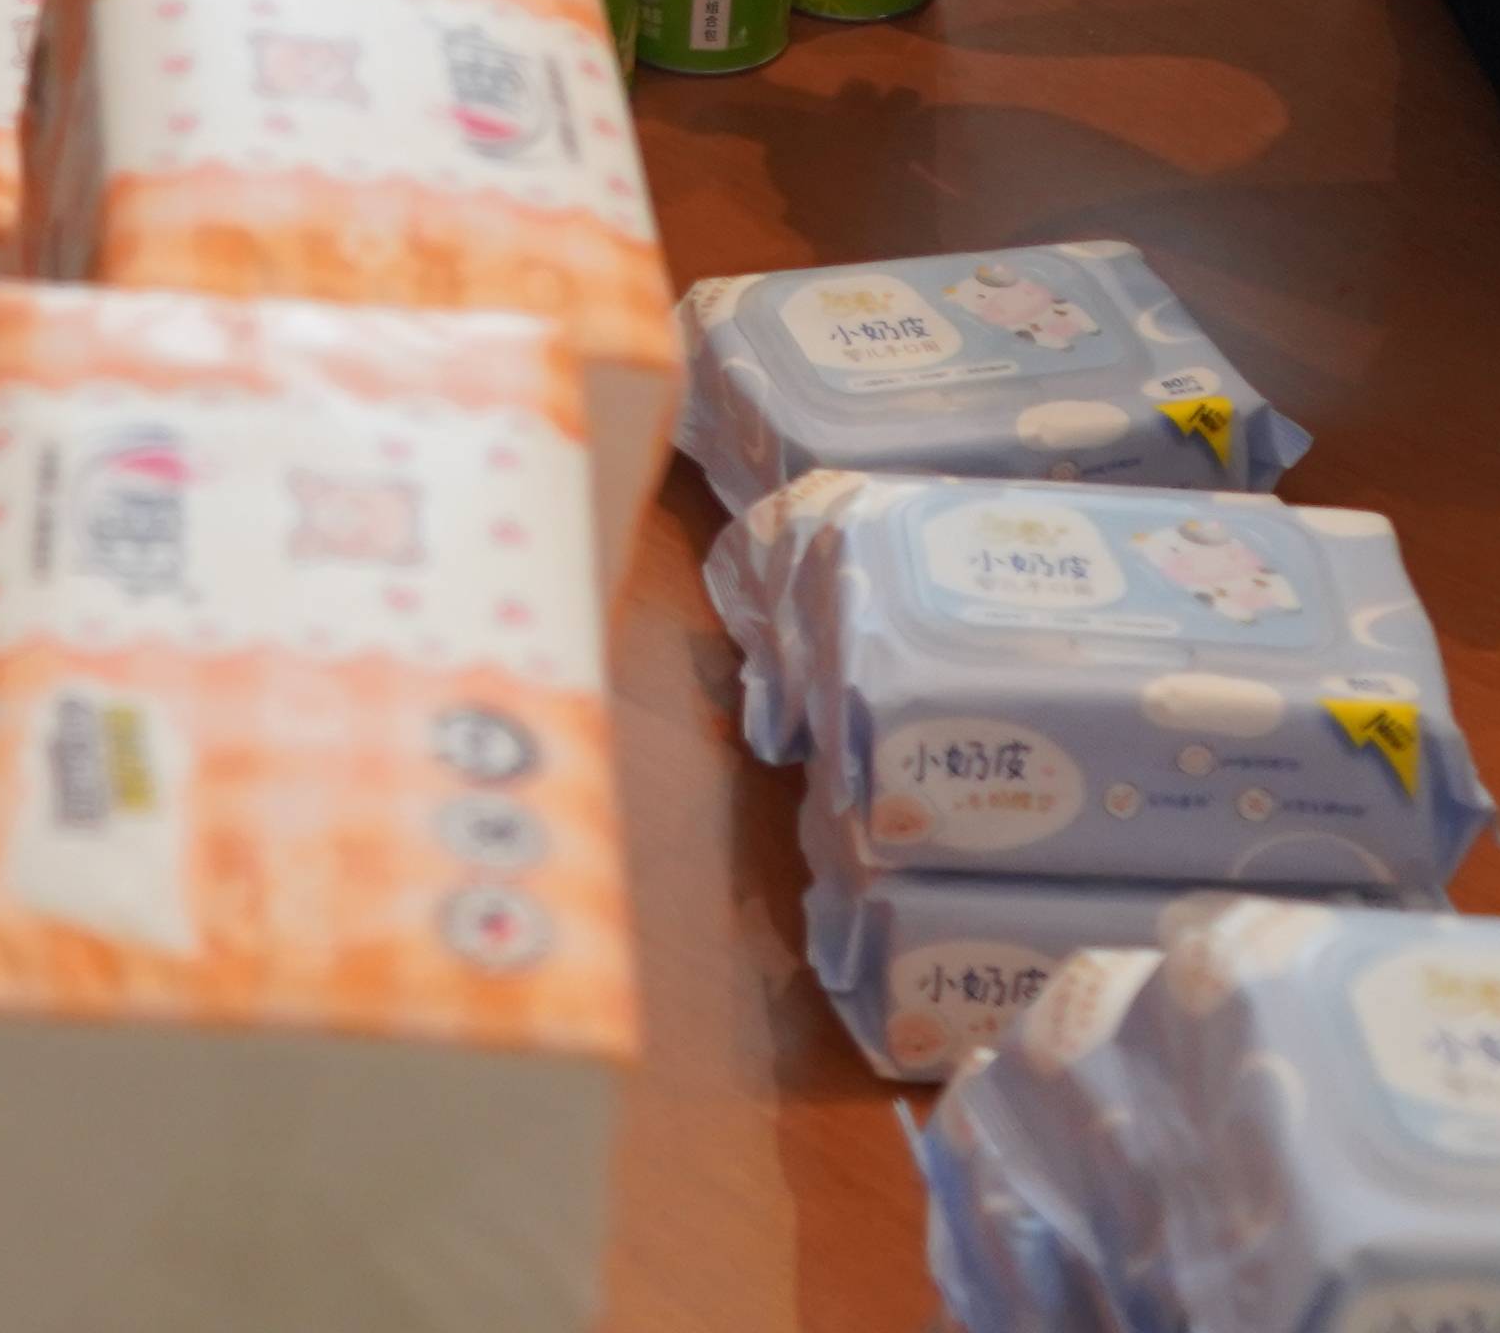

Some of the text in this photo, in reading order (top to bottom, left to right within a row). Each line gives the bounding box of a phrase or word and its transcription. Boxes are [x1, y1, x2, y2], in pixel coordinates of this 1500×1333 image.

[831, 316, 932, 346] 小奶皮
[968, 548, 1094, 579] 小奶皮
[902, 739, 1033, 782] 小奶皮
[918, 963, 1048, 1009] 小奶皮
